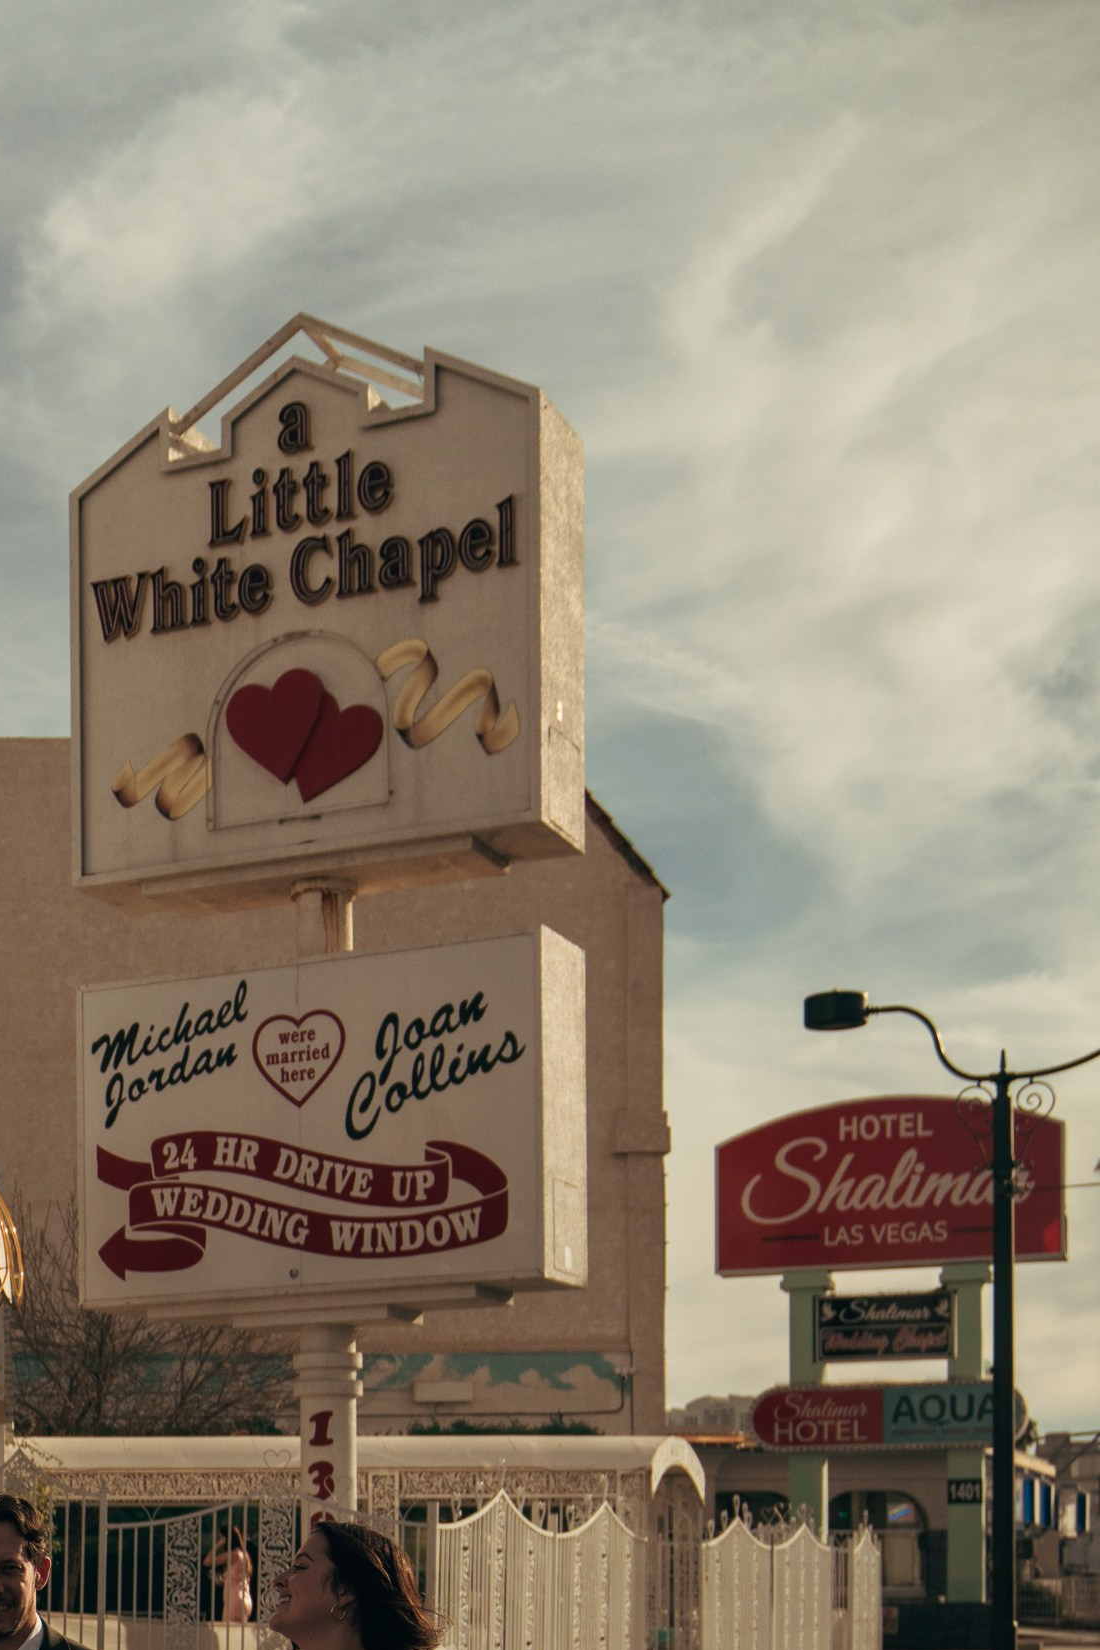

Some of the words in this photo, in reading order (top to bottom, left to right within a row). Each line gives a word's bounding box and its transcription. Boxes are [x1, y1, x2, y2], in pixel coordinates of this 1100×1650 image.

[277, 402, 310, 454] a
[208, 449, 395, 547] Little
[91, 557, 275, 643] White
[290, 494, 519, 605] Chapel
[91, 979, 248, 1073] Michael
[278, 1028, 316, 1045] were
[375, 991, 488, 1085] Joan
[265, 1043, 330, 1066] married
[105, 1043, 238, 1129] Jordan
[280, 1067, 316, 1084] here
[345, 1031, 526, 1141] Collins
[839, 1112, 933, 1142] HOTEL
[162, 1138, 198, 1170] 24
[213, 1136, 259, 1171] HR
[273, 1153, 373, 1201] DRIVE
[391, 1171, 436, 1201] UP
[151, 1187, 308, 1246] WEDDING
[330, 1207, 483, 1255] WINDOW
[823, 1225, 864, 1247] LAS
[870, 1221, 948, 1245] VEGAS
[839, 1299, 931, 1324] Shalimar
[774, 1394, 868, 1420] Shalimar
[892, 1392, 994, 1426] AQUA
[774, 1420, 868, 1443] HOTEL
[949, 1483, 981, 1500] 1401
